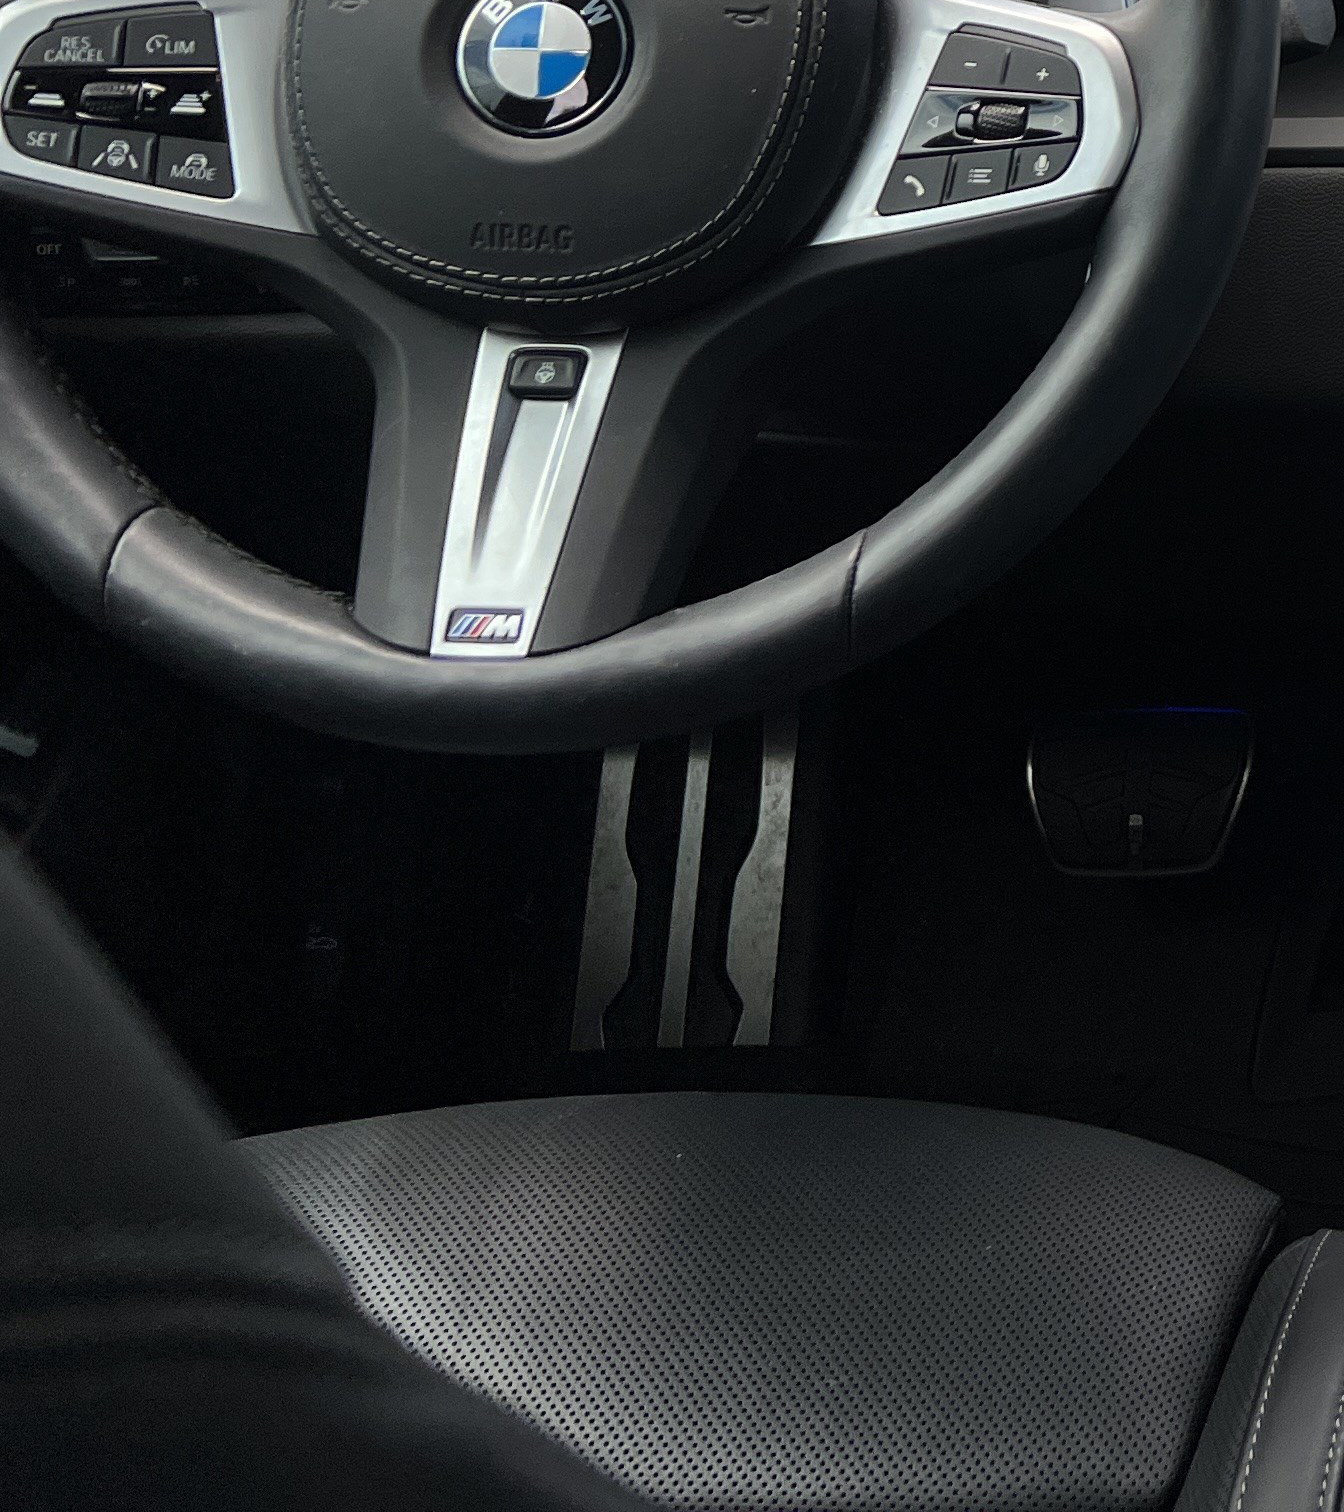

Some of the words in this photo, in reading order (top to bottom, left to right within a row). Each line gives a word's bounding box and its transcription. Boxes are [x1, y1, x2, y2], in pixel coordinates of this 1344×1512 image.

[164, 40, 196, 55] LIM
[26, 132, 59, 147] SET
[170, 165, 217, 181] MODE
[470, 221, 575, 254] AIRBAG
